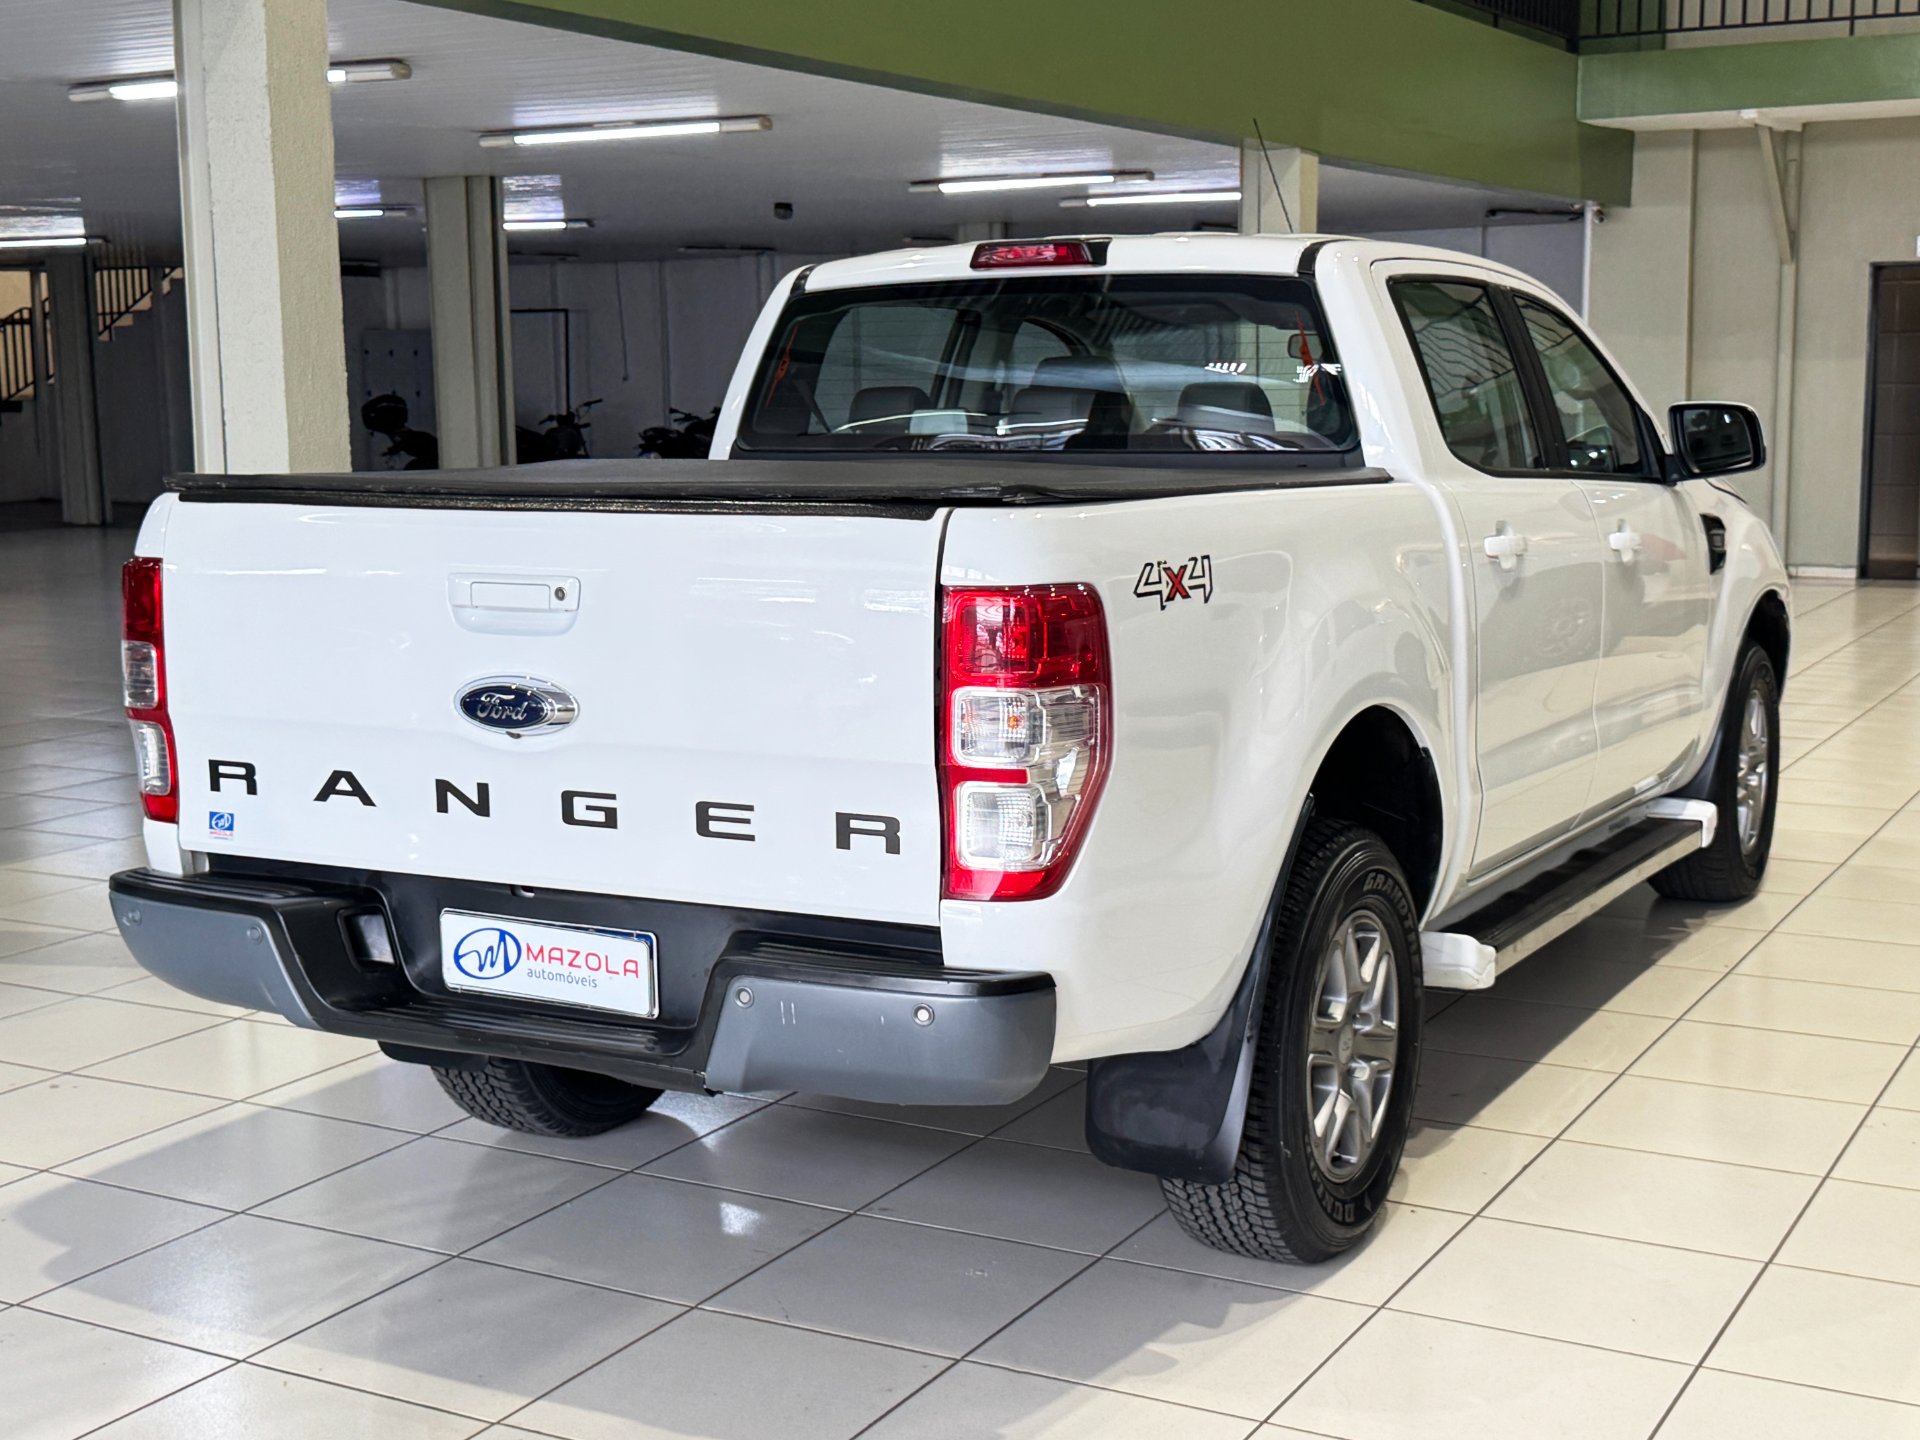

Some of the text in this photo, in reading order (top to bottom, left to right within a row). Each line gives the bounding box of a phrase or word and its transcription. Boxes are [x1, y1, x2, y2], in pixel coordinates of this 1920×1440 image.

[476, 692, 528, 720] Ford
[208, 759, 901, 855] RANGER
[526, 943, 639, 978] MAZOLA
[527, 966, 598, 988] automóveis
